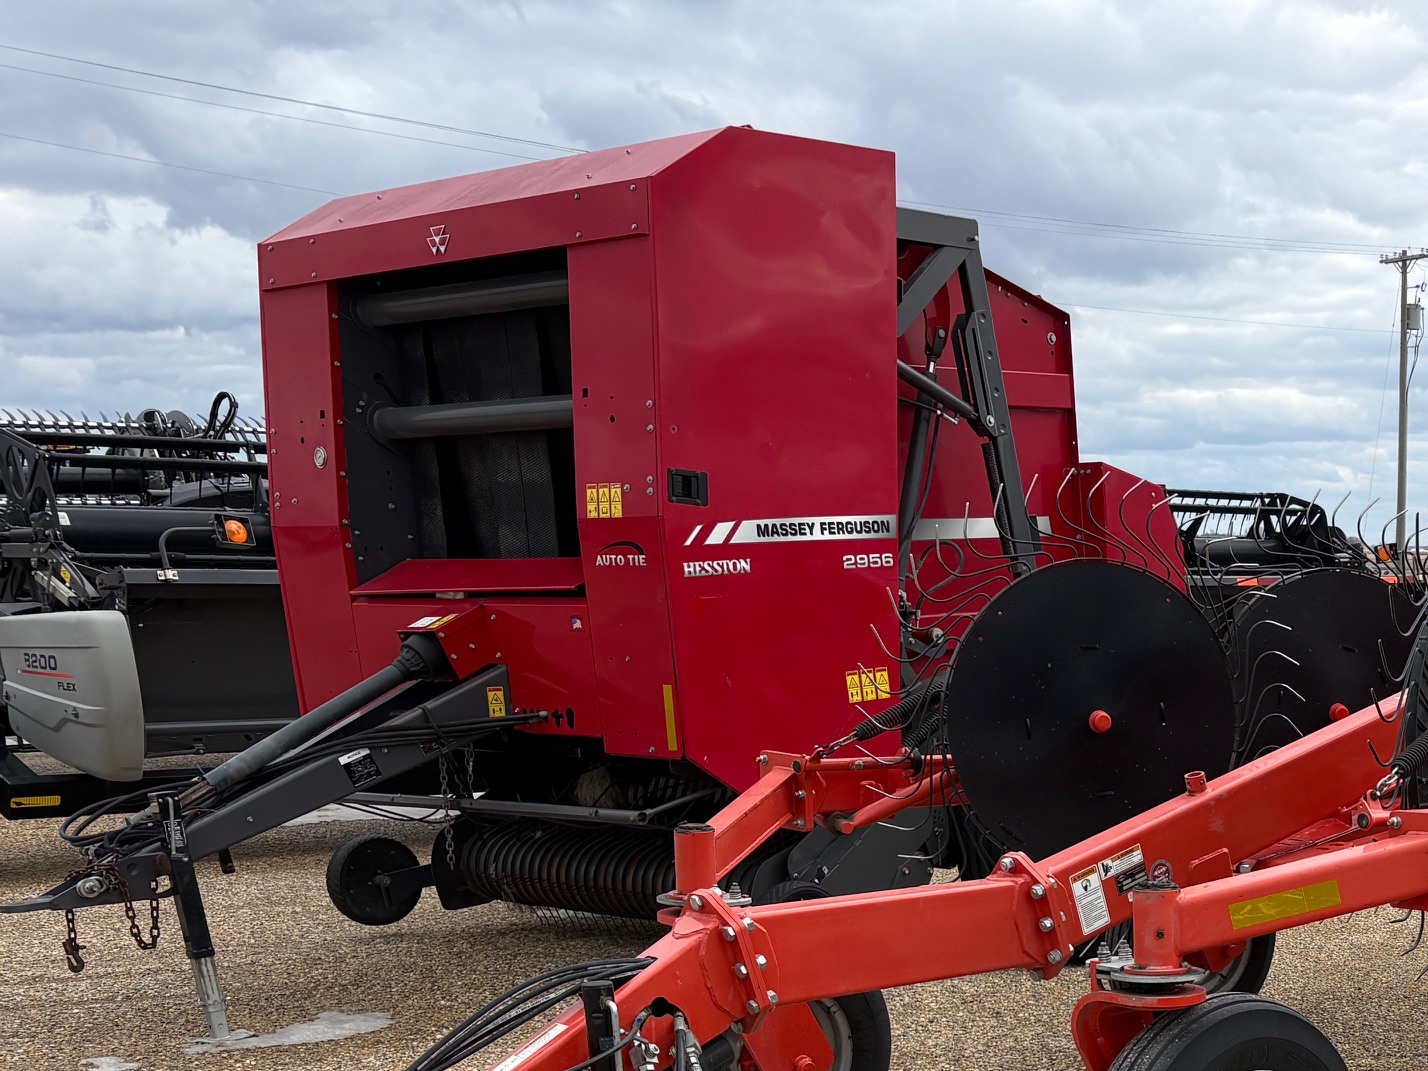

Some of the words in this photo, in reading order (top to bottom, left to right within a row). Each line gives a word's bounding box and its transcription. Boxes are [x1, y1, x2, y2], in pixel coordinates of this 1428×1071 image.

[756, 521, 815, 538] MASSEY
[819, 520, 891, 537] FERGUSON
[595, 554, 625, 567] AUTO
[627, 554, 648, 567] TIE
[682, 558, 752, 578] HESSTON
[842, 553, 895, 570] 2956
[57, 681, 78, 692] FLEX
